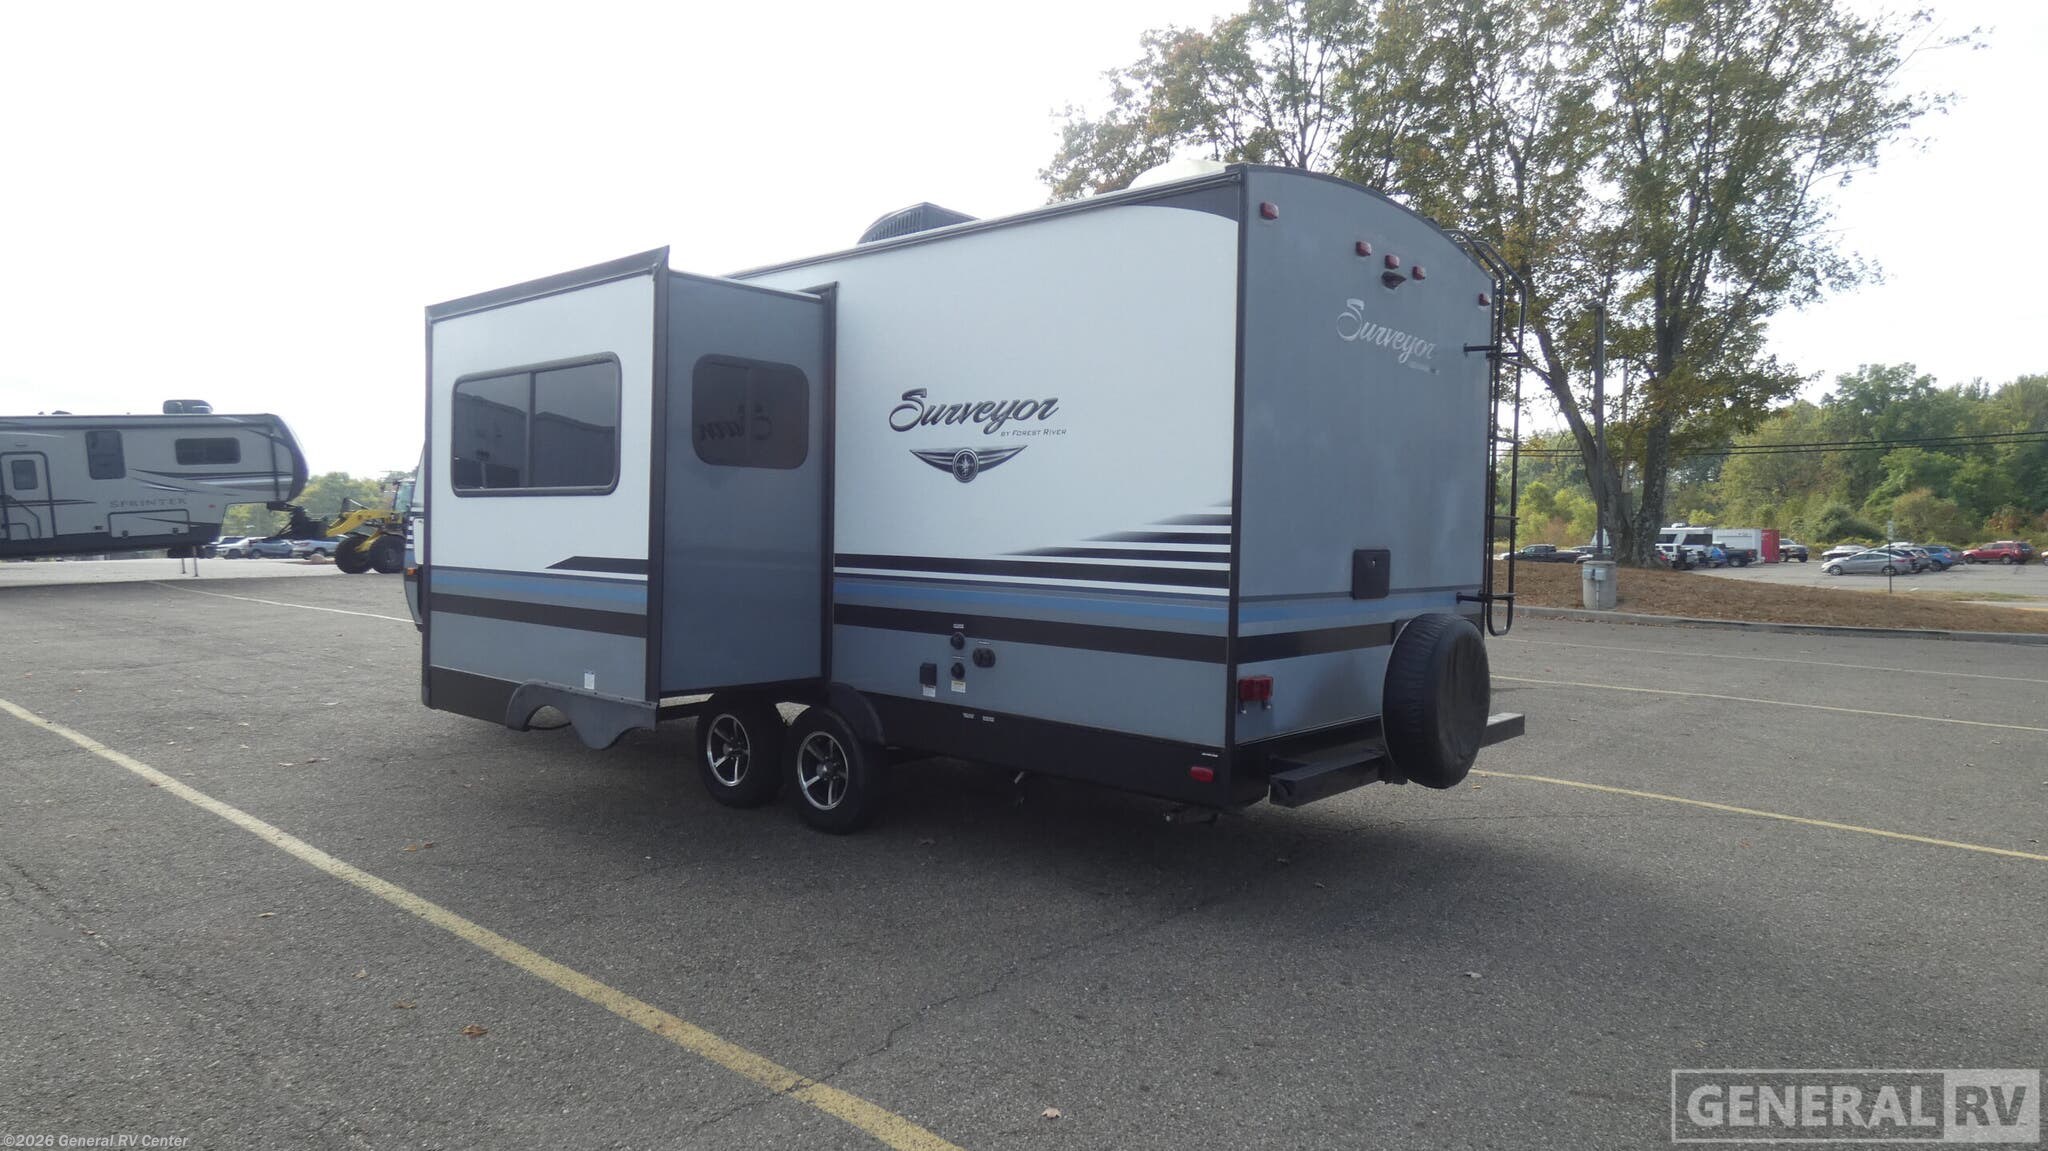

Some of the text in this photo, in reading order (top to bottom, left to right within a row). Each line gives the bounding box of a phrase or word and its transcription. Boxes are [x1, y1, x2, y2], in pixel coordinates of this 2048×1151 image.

[1336, 298, 1437, 363] Surveyor
[889, 388, 1059, 435] Surveyor
[1043, 428, 1067, 436] RIVER
[110, 498, 187, 508] SPRINTER
